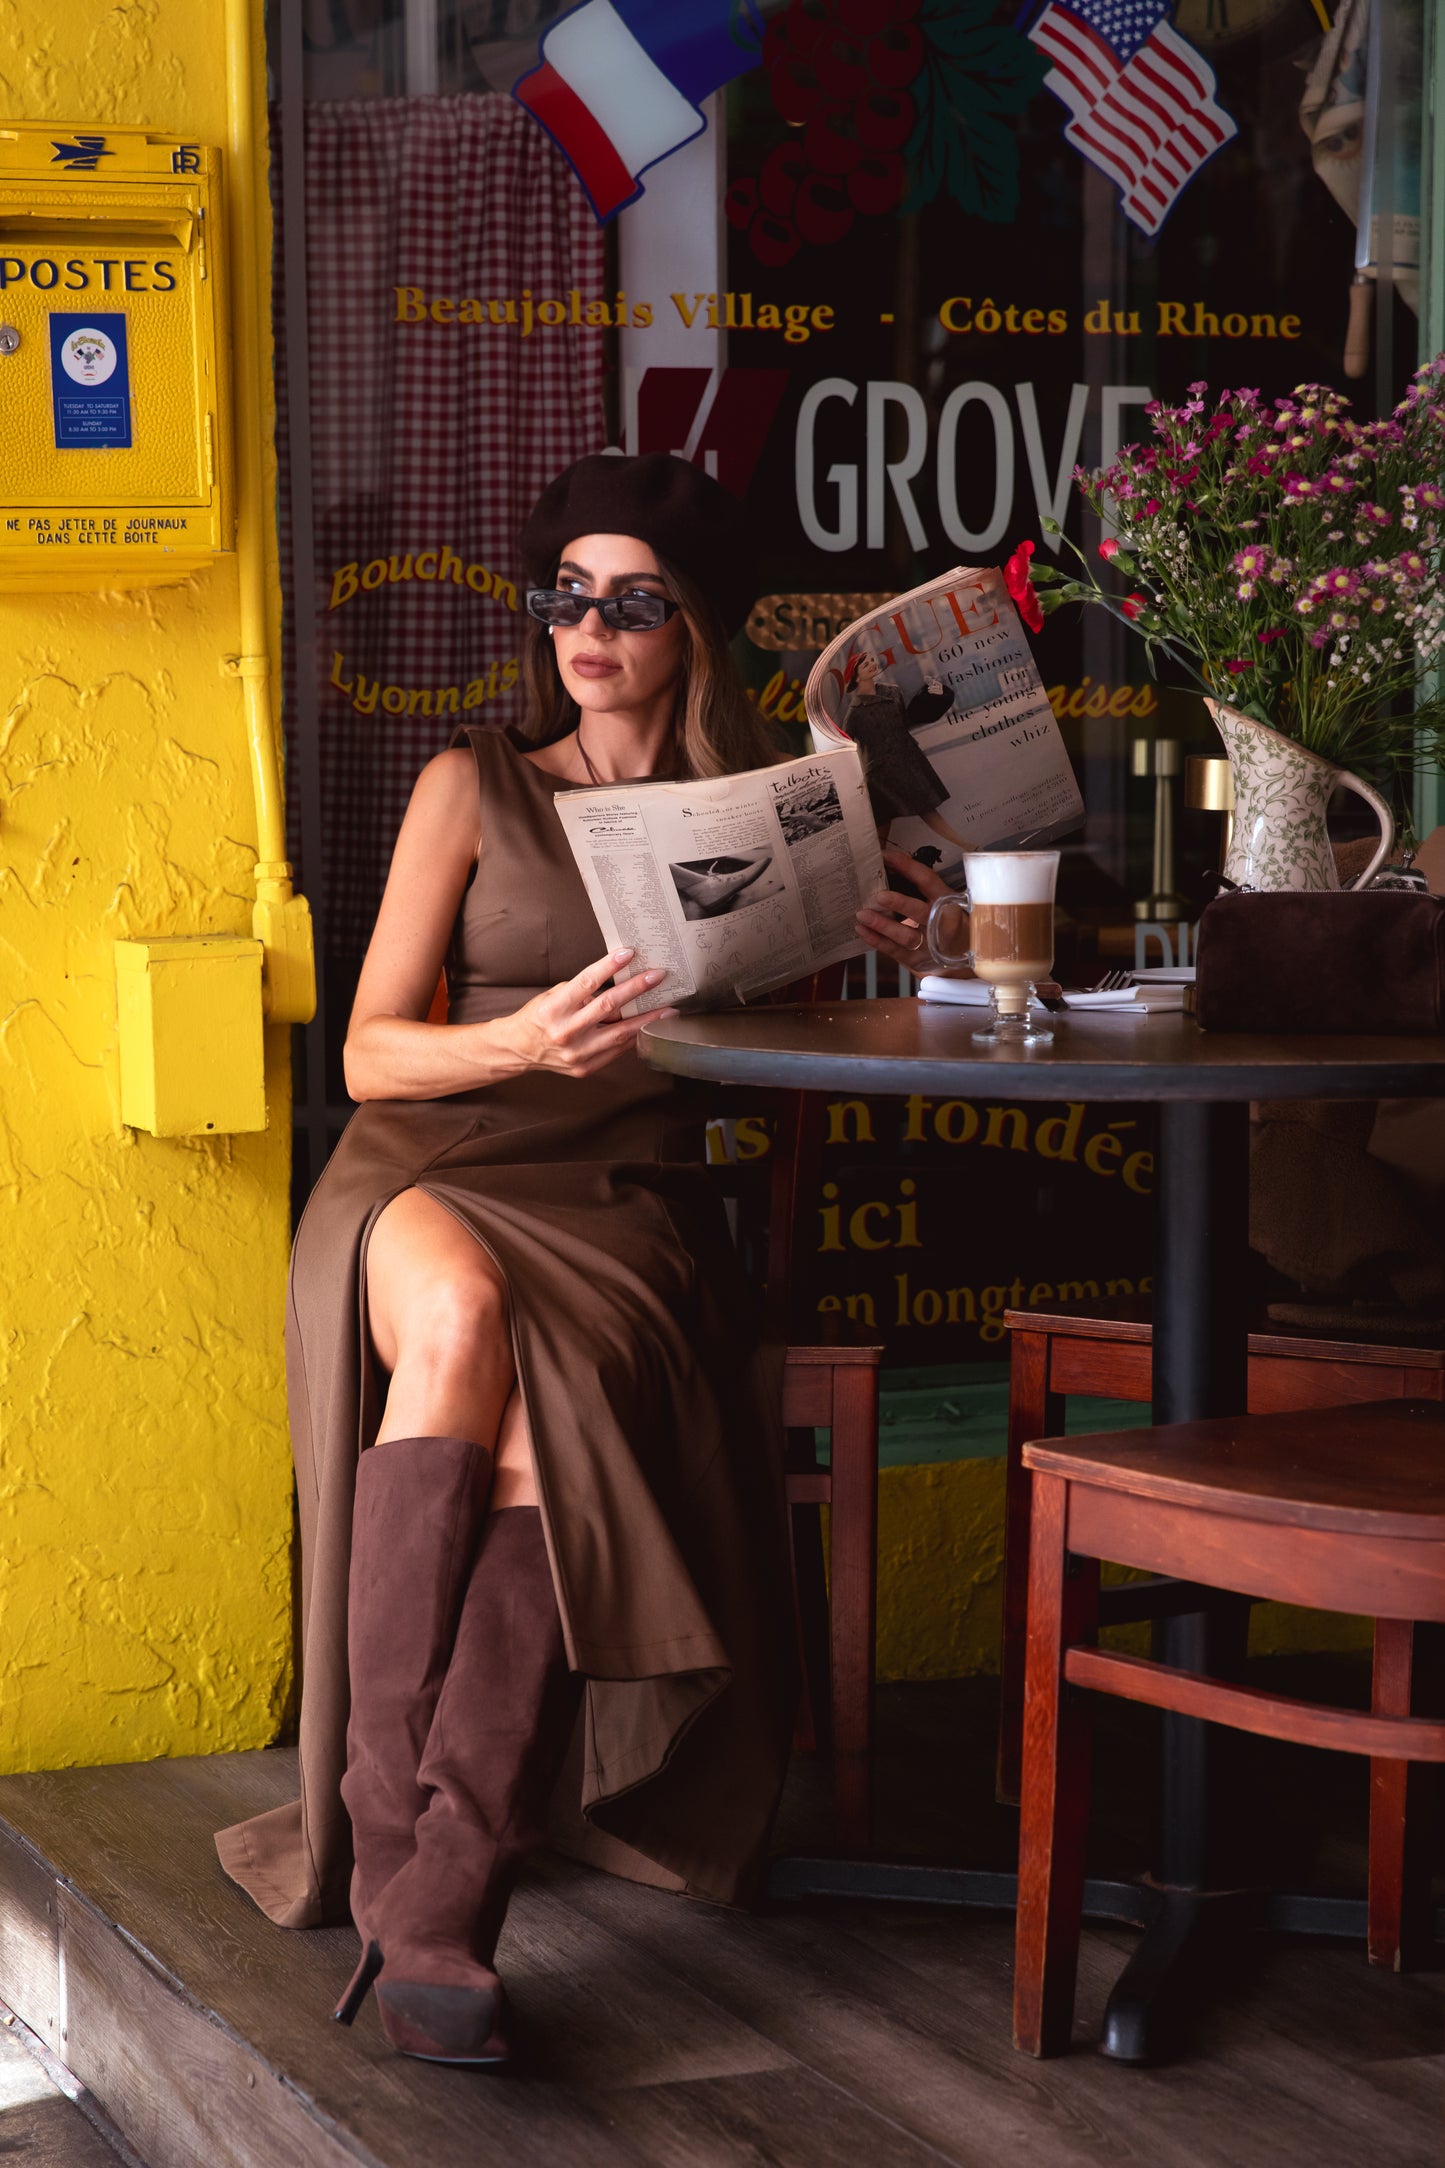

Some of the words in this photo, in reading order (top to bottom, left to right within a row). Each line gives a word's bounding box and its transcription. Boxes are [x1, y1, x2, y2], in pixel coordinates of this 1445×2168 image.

[0, 257, 176, 292] POSTES
[392, 285, 653, 339] Beaujolais
[670, 292, 836, 345] Village
[938, 296, 1069, 336] Côtes
[1083, 300, 1143, 336] du
[1155, 301, 1303, 340] Rhone
[6, 519, 20, 531] NE
[28, 519, 51, 531] PAS
[58, 519, 96, 531] JETER
[103, 519, 118, 531] DE
[126, 518, 188, 530] JOURNAUX
[37, 532, 70, 544] DANS
[78, 532, 117, 544] CETTE
[124, 532, 159, 543] BOITE
[328, 545, 519, 612] Bouchon
[938, 643, 964, 664] 60
[973, 630, 1011, 650] new
[329, 650, 519, 718] Lyonnais
[946, 649, 1023, 687] fashions
[1002, 667, 1029, 687] for
[946, 708, 975, 727] the
[982, 684, 1038, 719] young
[1009, 721, 1052, 749] whiz
[586, 806, 603, 814] Who
[816, 1178, 923, 1253] ici
